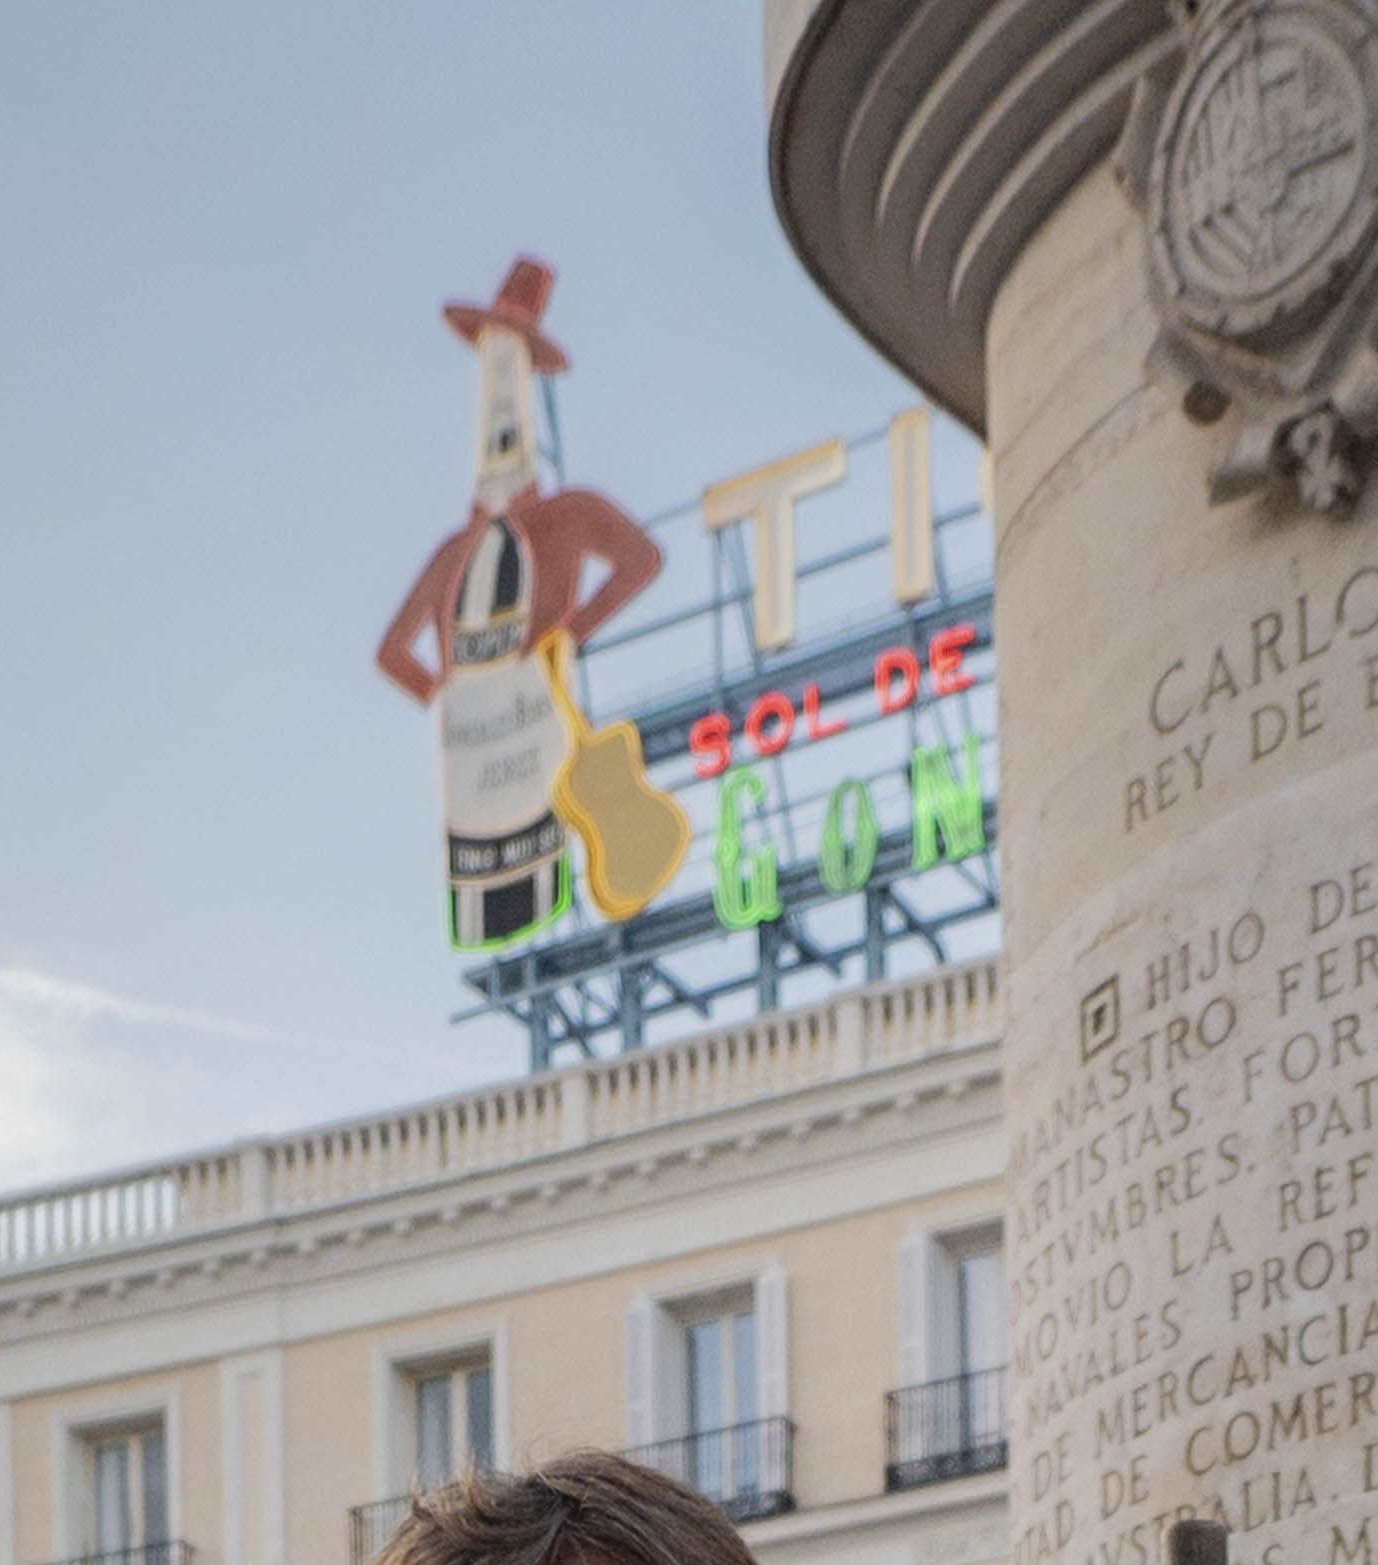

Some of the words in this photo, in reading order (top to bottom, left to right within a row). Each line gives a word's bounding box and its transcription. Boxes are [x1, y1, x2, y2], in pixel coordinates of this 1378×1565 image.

[702, 406, 995, 652] TI
[688, 684, 847, 779] SOL
[874, 624, 975, 715] DE
[1125, 734, 1213, 833] REY
[1250, 681, 1321, 762] DE
[712, 732, 985, 930] GON
[1144, 912, 1265, 1011] HIJO
[1170, 1214, 1234, 1278] LA
[1033, 1431, 1073, 1503] DE
[1100, 1454, 1150, 1521] DE
